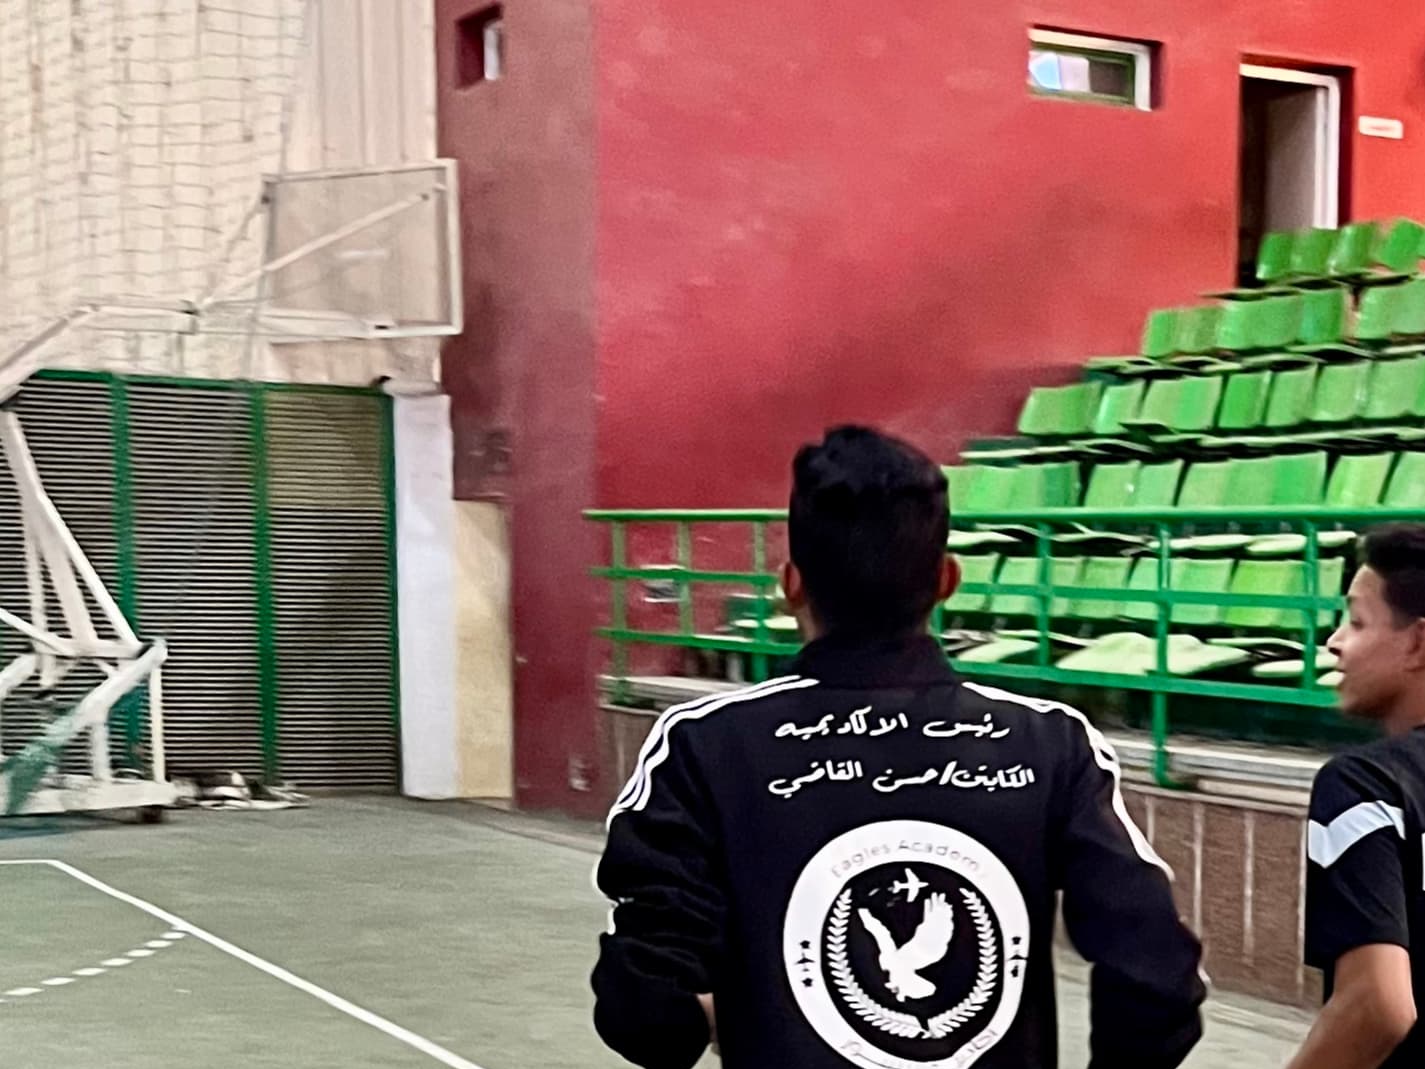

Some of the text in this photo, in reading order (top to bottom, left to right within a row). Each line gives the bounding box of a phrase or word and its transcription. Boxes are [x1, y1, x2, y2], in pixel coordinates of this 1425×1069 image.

[922, 712, 1011, 739] رئيس
[767, 760, 863, 799] القاضي
[898, 839, 988, 878] Academ
